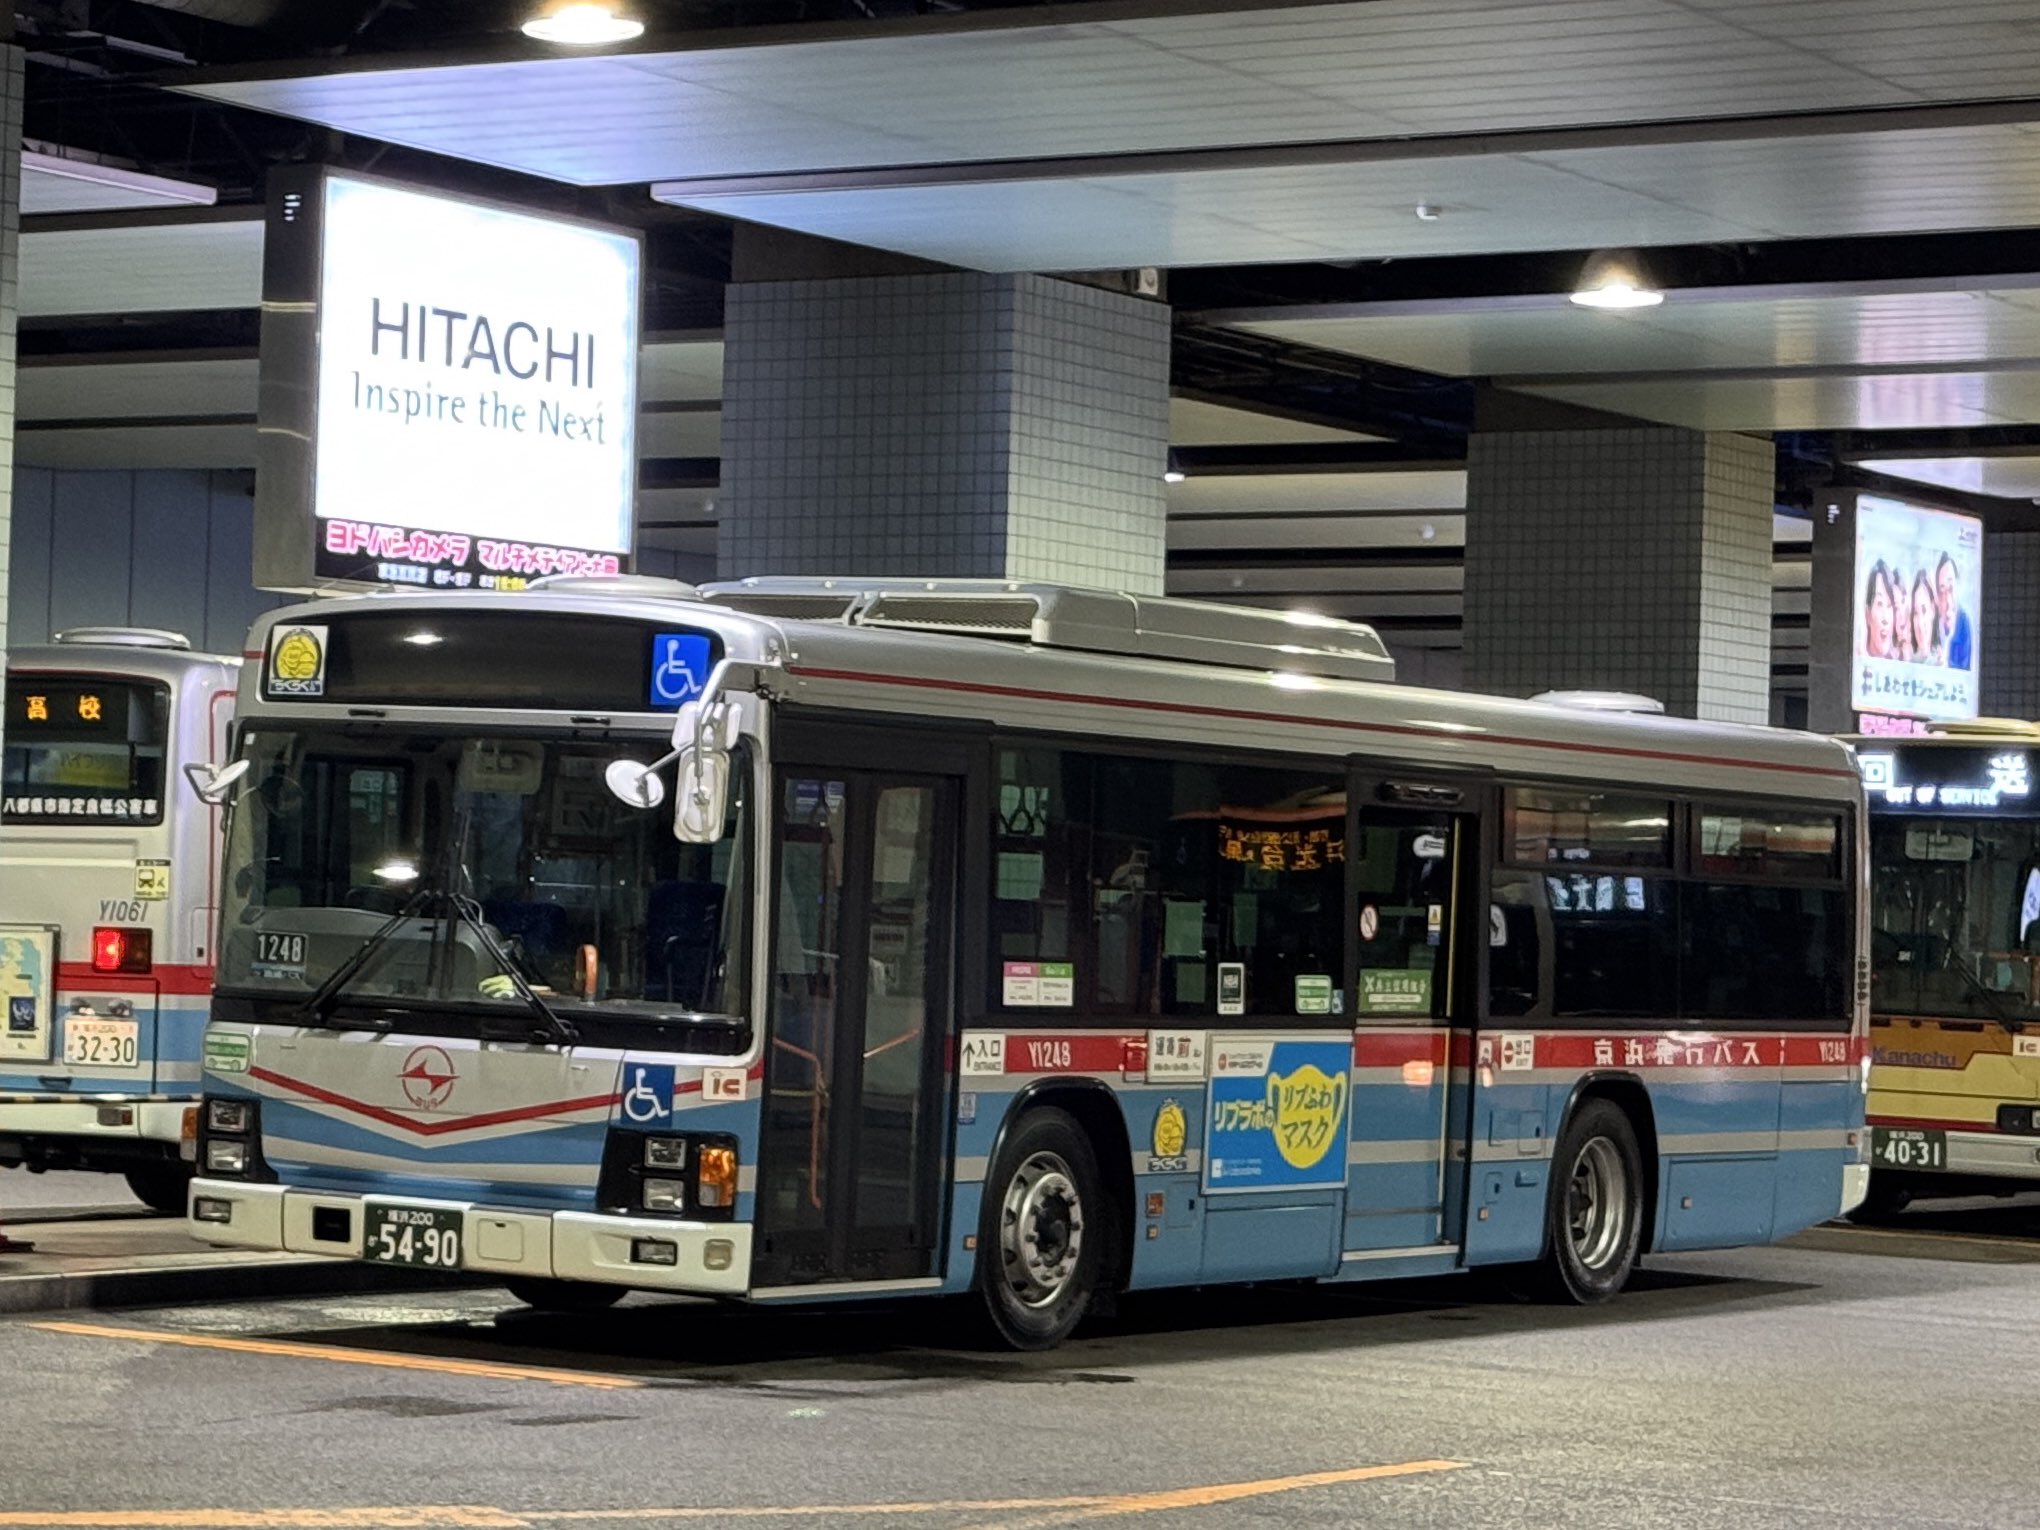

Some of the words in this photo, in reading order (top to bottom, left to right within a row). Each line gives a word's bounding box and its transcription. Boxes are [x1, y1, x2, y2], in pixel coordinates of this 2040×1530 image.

[371, 297, 595, 388] HITACHI
[353, 370, 466, 425] Inspire
[479, 390, 526, 432] the
[539, 400, 606, 445] Next
[326, 519, 471, 567] ヨドバシカメラ
[1857, 753, 1894, 790] 回
[258, 934, 302, 962] 1248
[76, 1034, 135, 1063] 32-30
[976, 1039, 1001, 1057] 入口
[1027, 1040, 1071, 1068] Y1248
[1872, 1045, 1957, 1067] Kanachu
[1281, 1115, 1329, 1150] マスク
[1884, 1140, 1940, 1166] 40-31
[380, 1223, 458, 1266] 54-90
